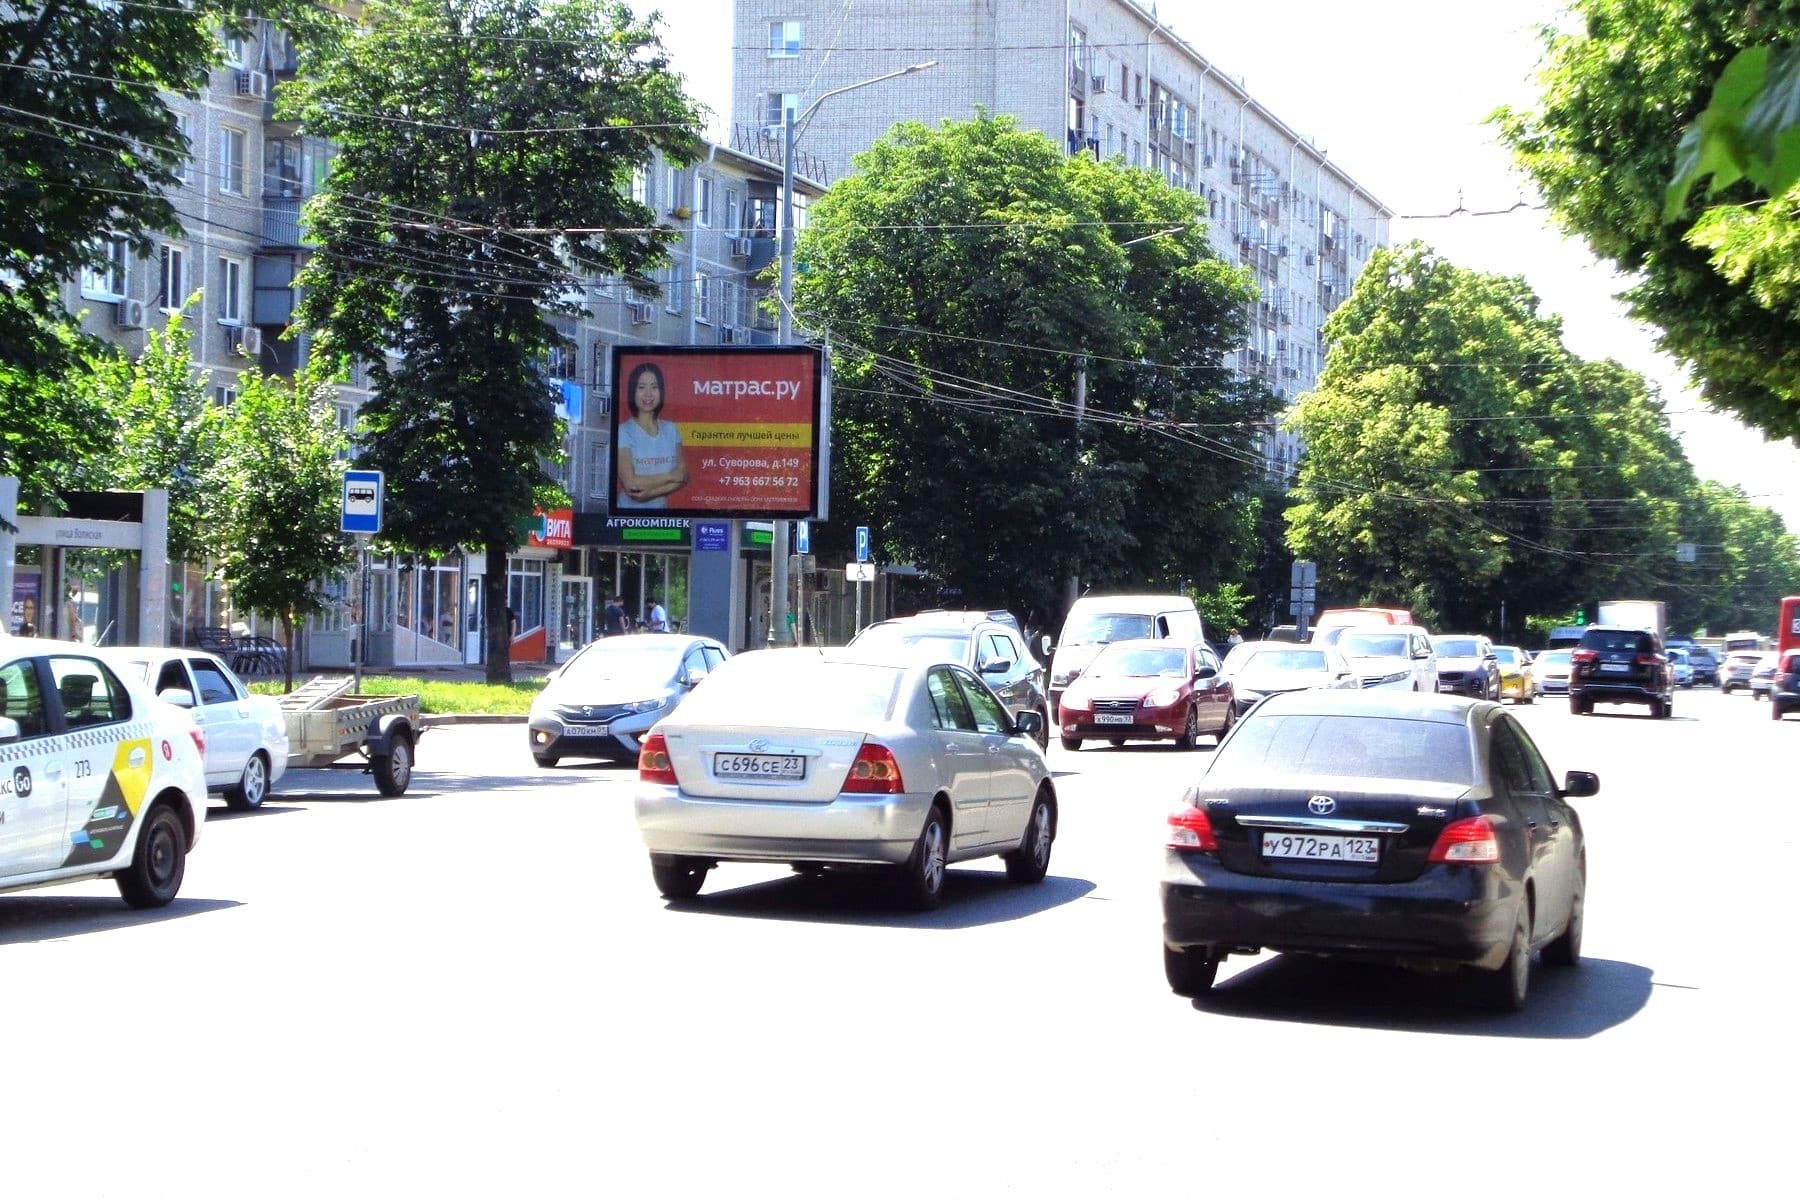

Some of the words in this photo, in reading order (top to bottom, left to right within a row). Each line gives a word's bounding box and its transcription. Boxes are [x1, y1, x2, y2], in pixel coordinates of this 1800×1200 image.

[693, 380, 801, 400] матрас.ру
[691, 430, 735, 441] Гарантия
[736, 430, 772, 442] лучшей
[774, 432, 800, 442] цены
[702, 459, 717, 469] ул.
[719, 457, 770, 469] Суворова,
[772, 458, 800, 470] д.149
[719, 476, 732, 486] +7
[733, 476, 750, 486] 963
[752, 477, 770, 487] 667
[772, 477, 785, 487] 56
[786, 477, 799, 487] 72
[546, 518, 571, 538] ВИТА
[859, 530, 867, 557] P
[75, 760, 91, 778] 273
[721, 757, 780, 773] С696СЕ
[783, 758, 799, 770] 23
[15, 772, 30, 792] Go
[1270, 836, 1341, 858] У972РА
[1346, 839, 1374, 854] 123
